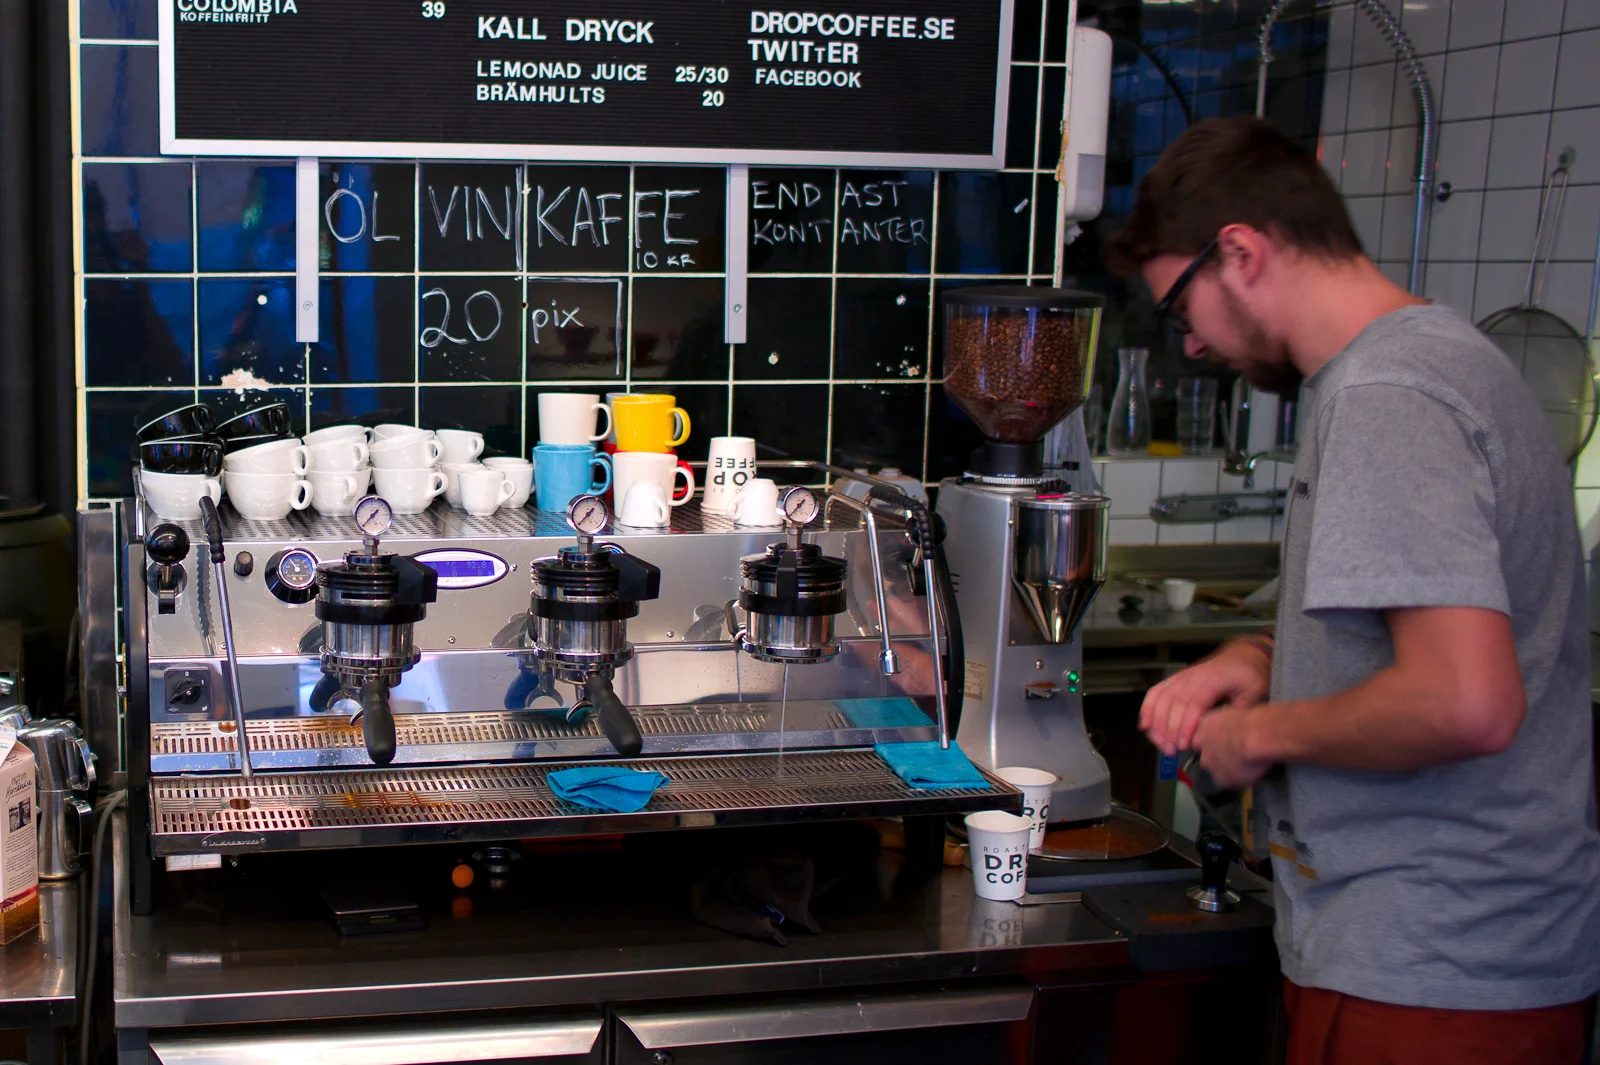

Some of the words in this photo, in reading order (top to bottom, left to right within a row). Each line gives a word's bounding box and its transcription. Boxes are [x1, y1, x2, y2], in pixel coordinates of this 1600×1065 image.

[177, 0, 298, 14] COLOMBIA
[422, 2, 446, 19] 39
[180, 12, 270, 23] KOFFEINFRITT
[478, 16, 547, 40] KALL
[565, 19, 655, 44] DRYCK
[750, 11, 955, 40] DROPCOFFEE.SE
[747, 39, 859, 64] TWITTER
[476, 60, 582, 80] LEMONAD
[591, 64, 648, 82] JUICE
[675, 66, 729, 84] 25/30
[755, 68, 862, 88] FACEBOOK
[476, 82, 606, 104] BRÄMHULTS
[702, 90, 724, 107] 20
[325, 171, 400, 243] ÖL
[428, 185, 510, 241] VIN
[536, 185, 700, 249] KAFFE
[636, 252, 657, 269] 10
[667, 254, 695, 265] KR
[419, 287, 504, 348] 20
[984, 854, 1028, 870] DR
[986, 870, 1027, 884] COF
